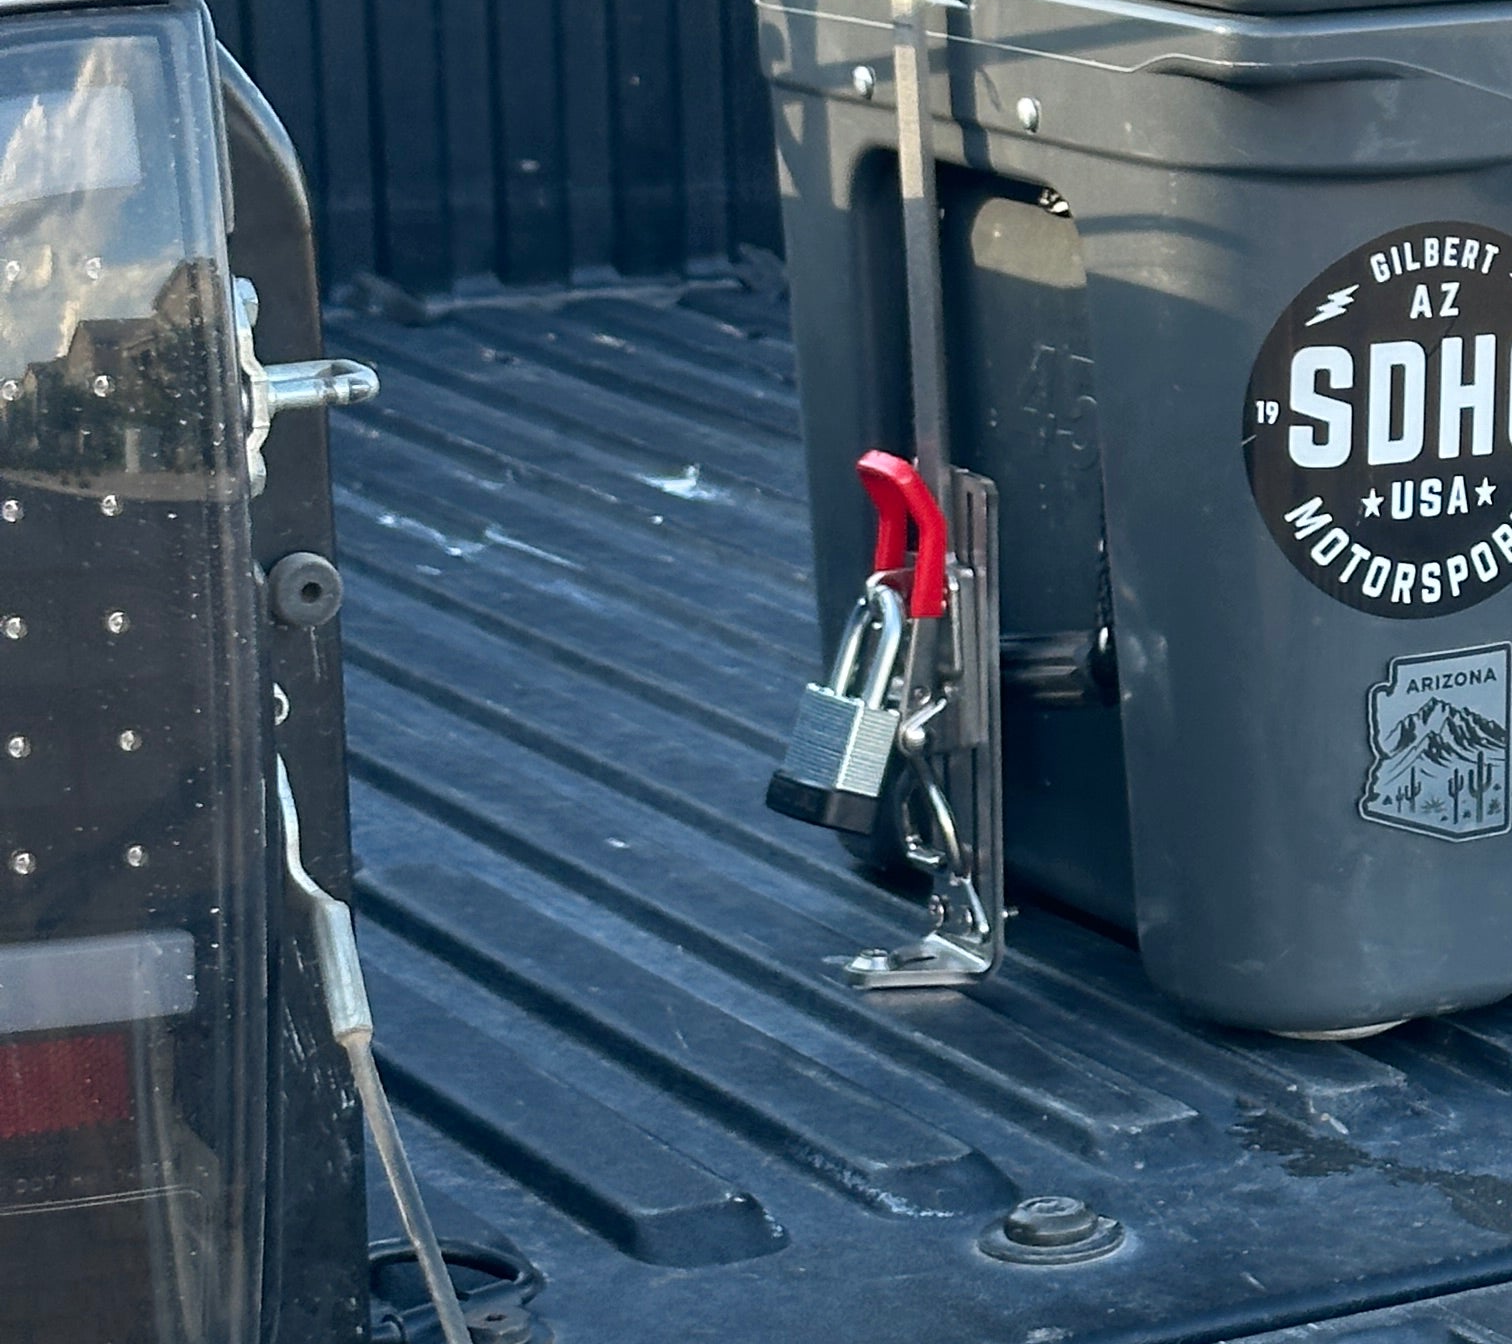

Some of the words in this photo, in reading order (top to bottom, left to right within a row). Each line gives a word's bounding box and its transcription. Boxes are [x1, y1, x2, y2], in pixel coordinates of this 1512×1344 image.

[1370, 236, 1500, 283] GILBERT
[1410, 282, 1460, 319] AZ
[1256, 400, 1280, 425] 19
[1391, 476, 1469, 520] USA
[1406, 666, 1497, 695] ARIZONA
